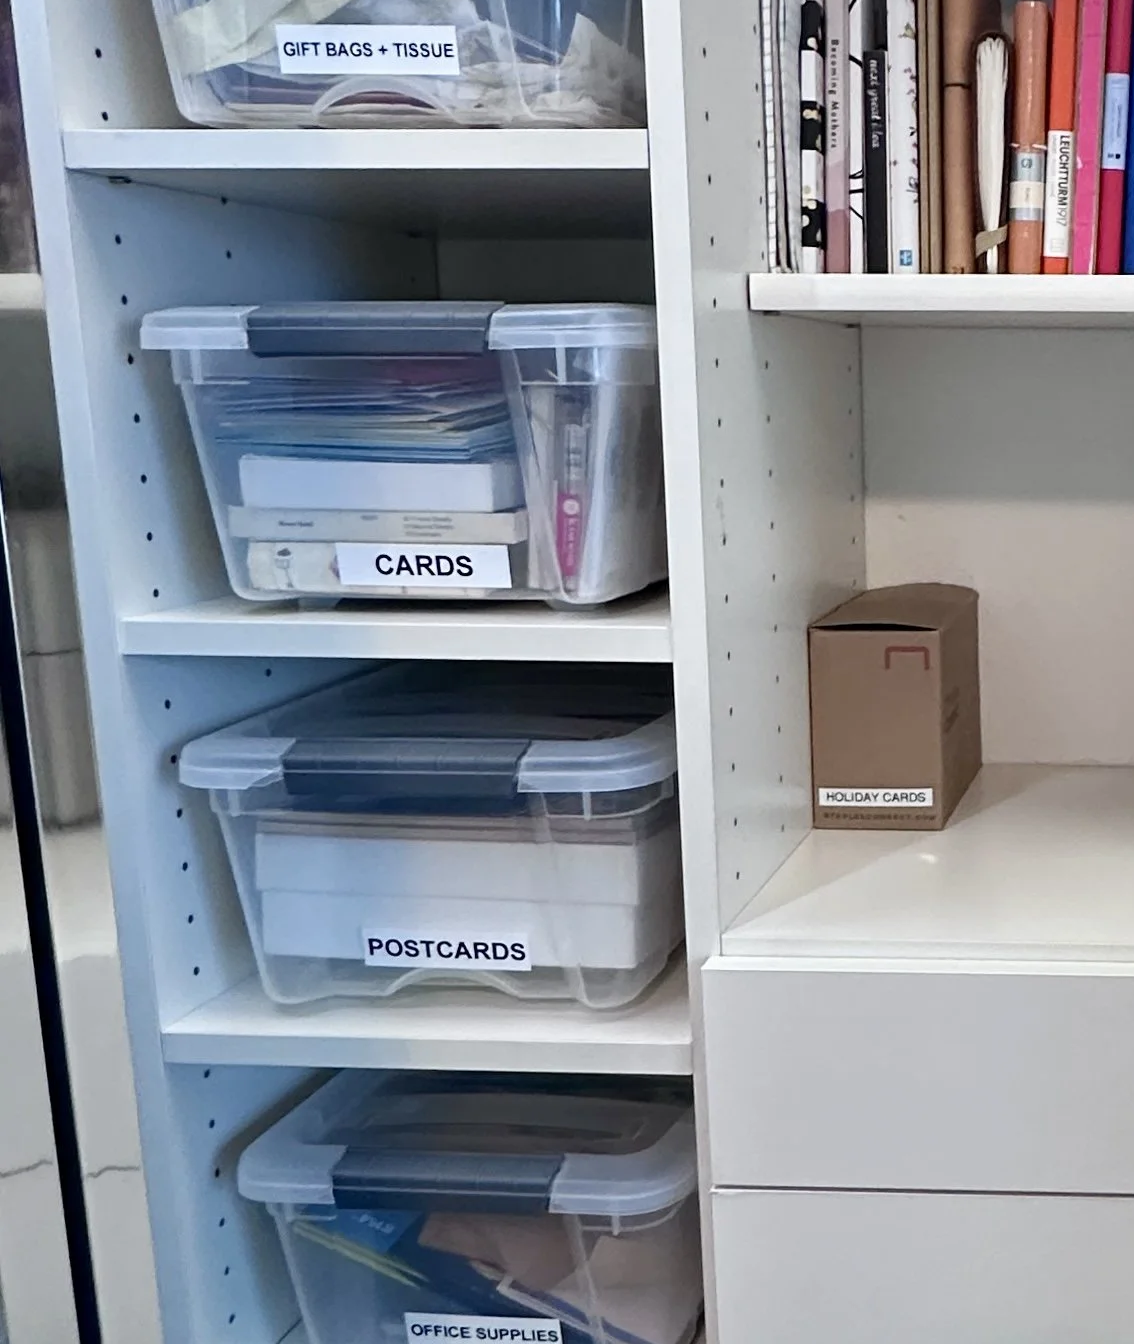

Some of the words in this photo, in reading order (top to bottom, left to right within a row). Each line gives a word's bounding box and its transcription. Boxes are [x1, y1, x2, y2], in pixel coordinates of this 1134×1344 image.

[283, 41, 321, 57] GIFT
[325, 42, 373, 58] BAGS
[379, 44, 389, 55] +
[392, 42, 455, 58] TISSUE
[828, 39, 840, 95] Becoming
[831, 101, 840, 148] Mothers
[1056, 135, 1071, 227] LEUCHTTURM1917
[375, 553, 474, 577] CARDS
[826, 791, 880, 803] HOLIDAY
[882, 791, 927, 803] CARDS
[367, 937, 526, 961] POSTCARDS
[410, 1323, 472, 1339] OFFICE
[475, 1327, 559, 1343] SUPPLIES
